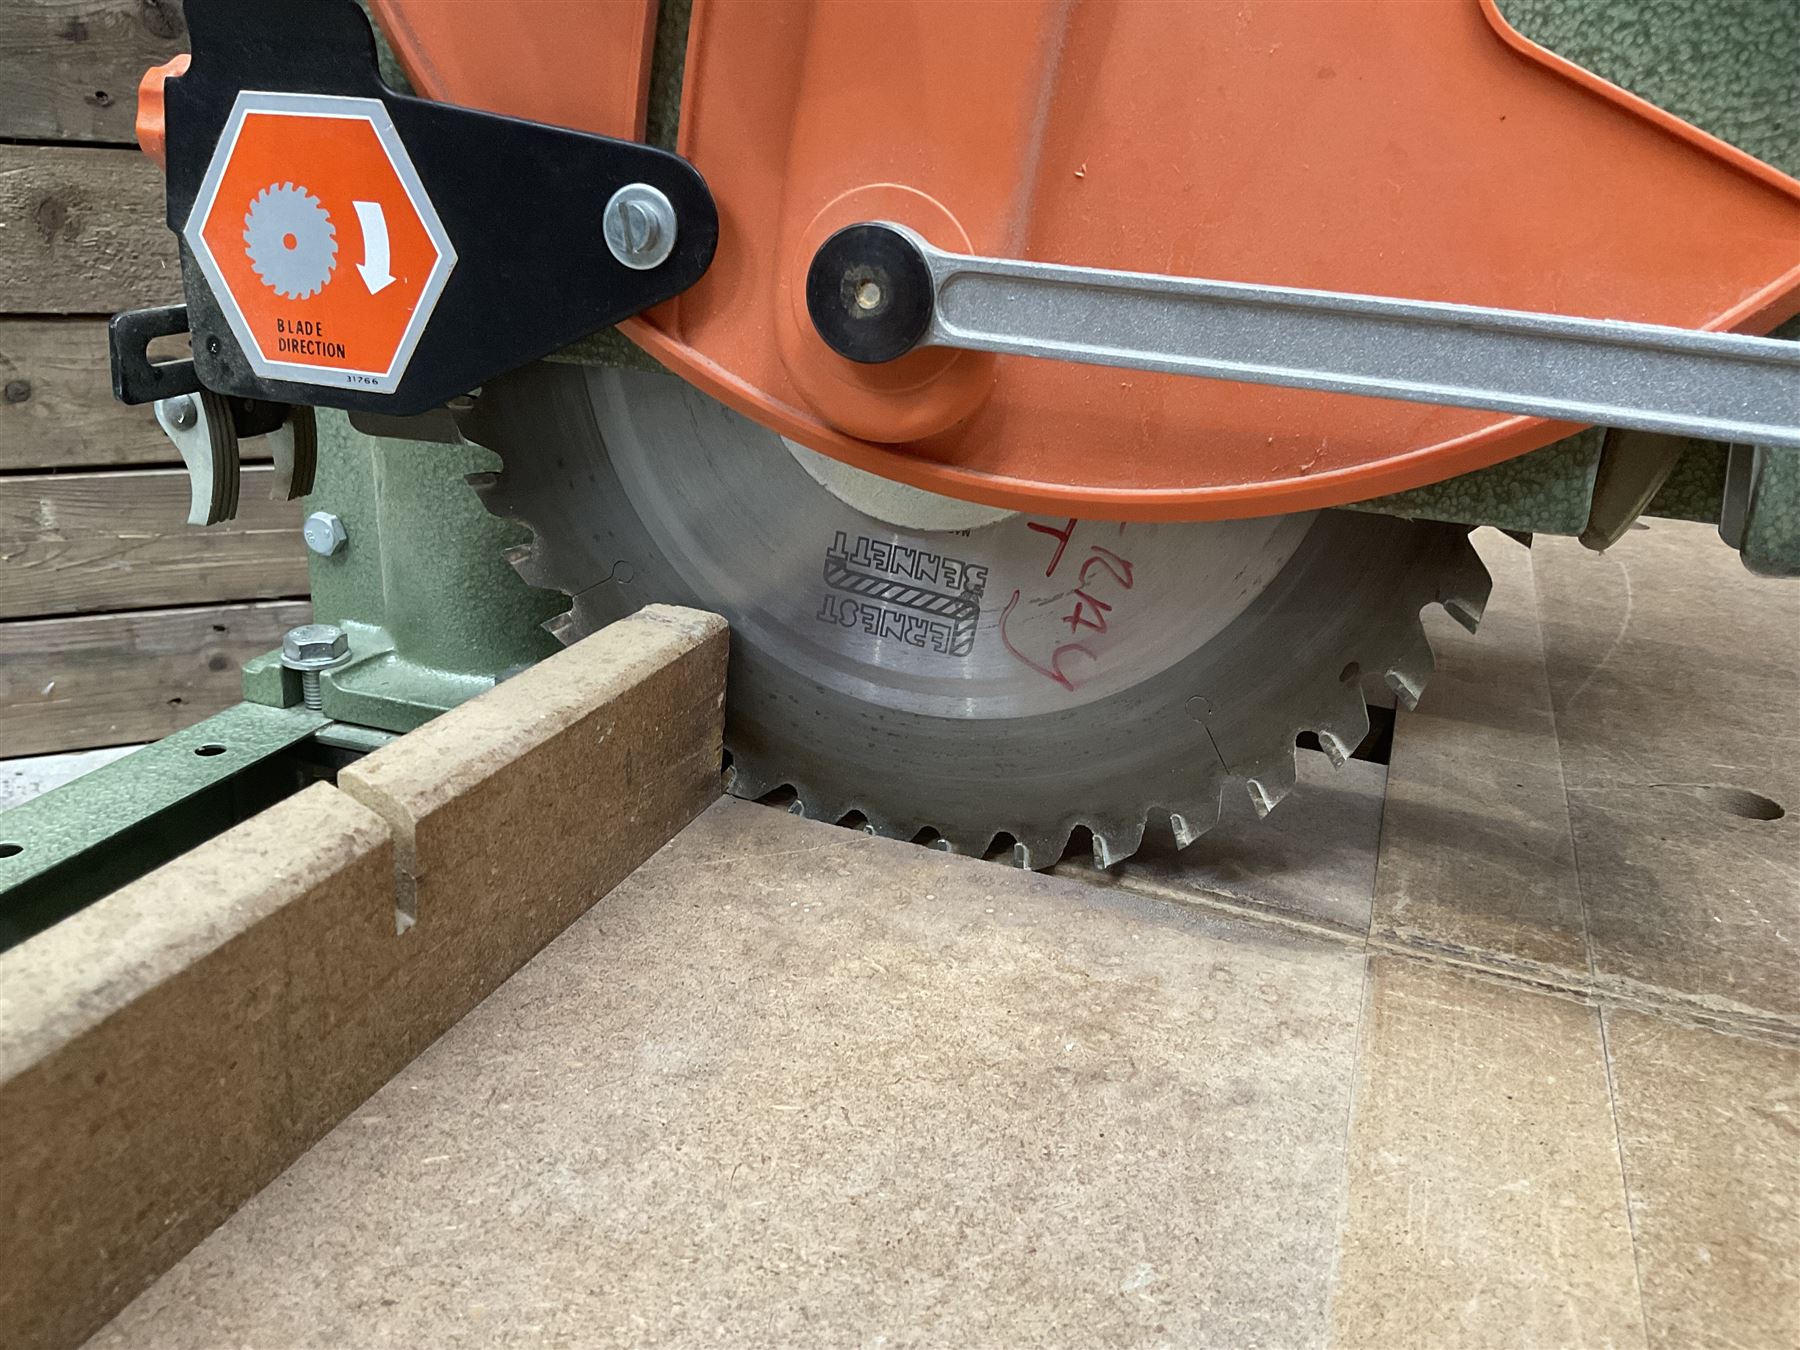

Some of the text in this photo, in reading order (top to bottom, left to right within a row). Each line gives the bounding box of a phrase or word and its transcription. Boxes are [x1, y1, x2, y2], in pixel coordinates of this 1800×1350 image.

[277, 318, 323, 337] BLADE
[278, 338, 346, 359] DIRECTION
[346, 375, 379, 385] 31766
[826, 531, 989, 600] BENNETT
[816, 594, 953, 655] ERNEST
